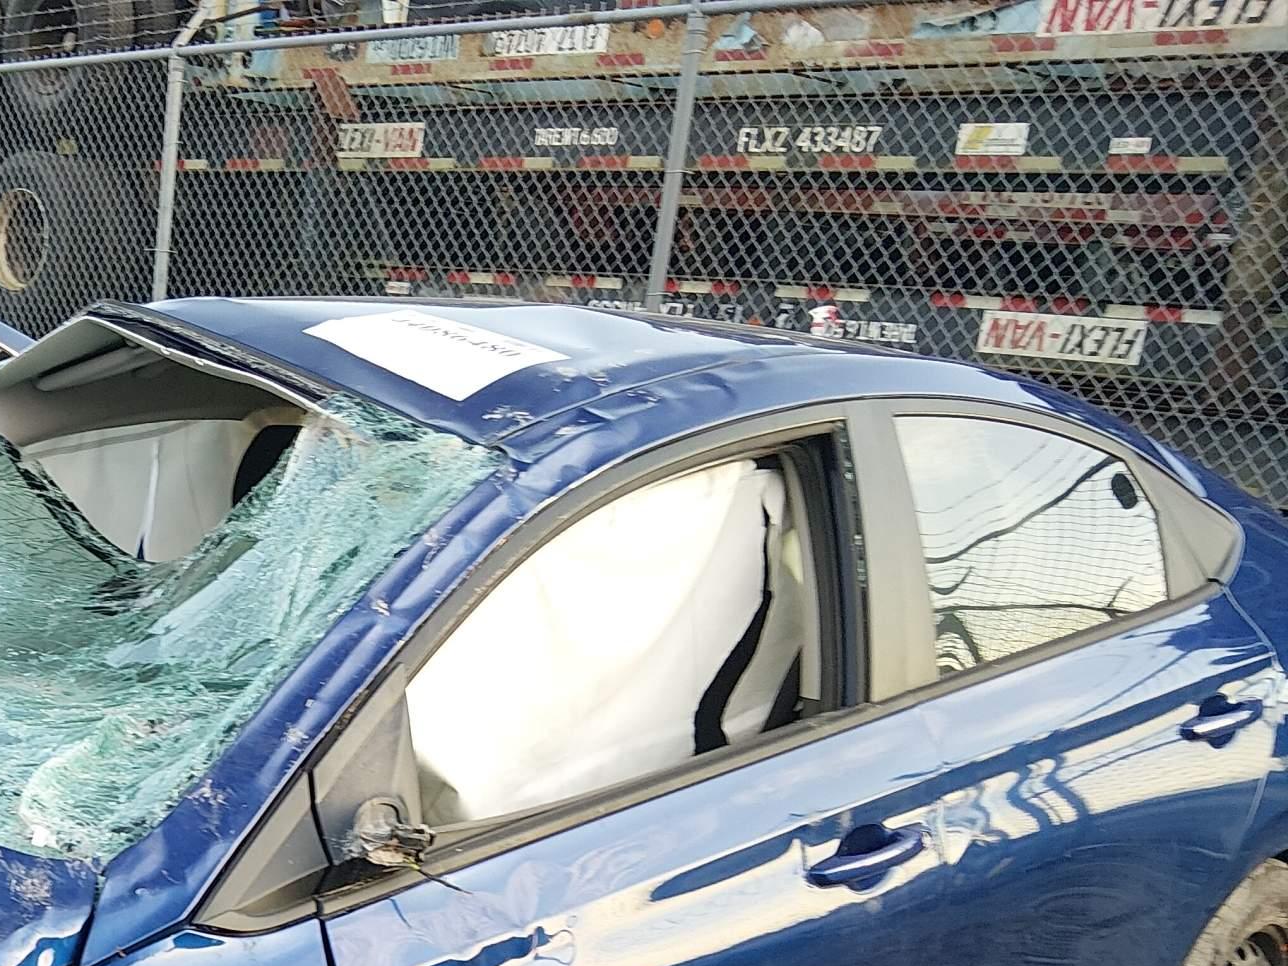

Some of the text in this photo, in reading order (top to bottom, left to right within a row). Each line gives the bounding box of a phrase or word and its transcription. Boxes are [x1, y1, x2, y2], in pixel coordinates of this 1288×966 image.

[737, 125, 883, 152] FLXZ 433487
[985, 316, 1144, 360] FLEXI-VAN
